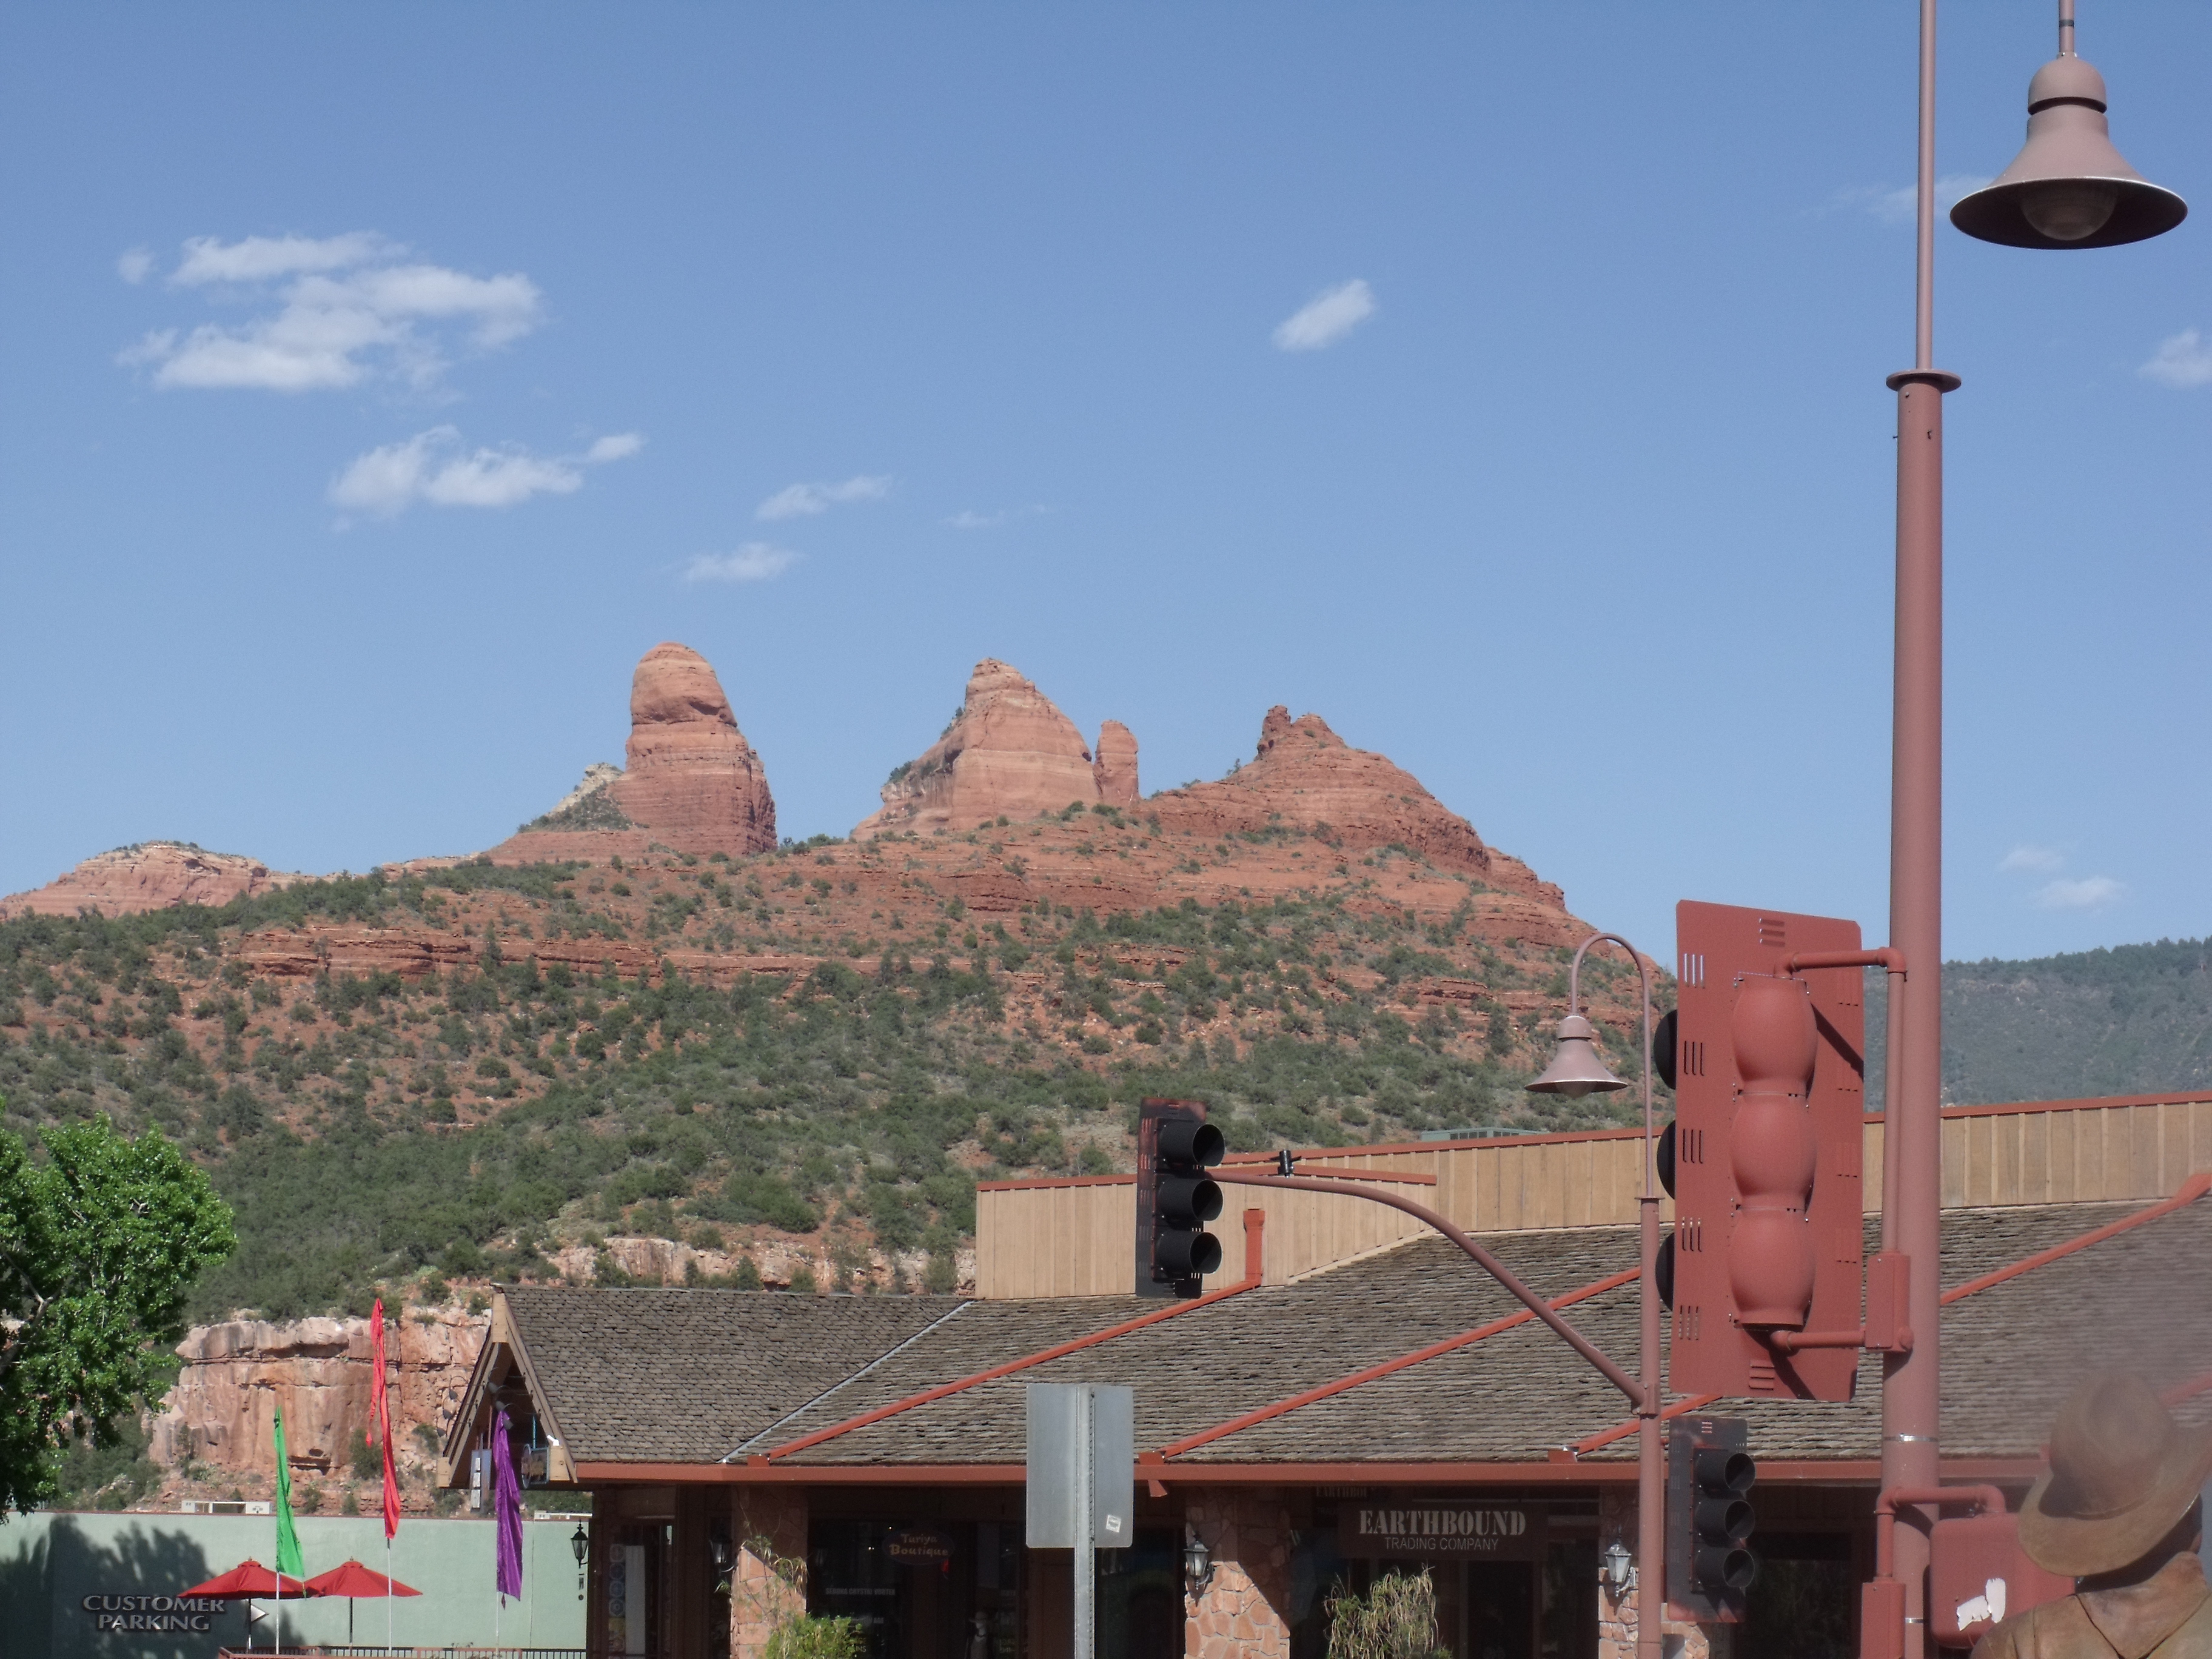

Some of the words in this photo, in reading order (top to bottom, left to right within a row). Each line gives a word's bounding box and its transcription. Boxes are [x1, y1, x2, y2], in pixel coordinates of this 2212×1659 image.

[1359, 1510, 1526, 1535] EARTHBOUND
[900, 1533, 937, 1546] Turiya
[1385, 1537, 1436, 1550] TRADING
[1439, 1538, 1498, 1550] COMPANY
[888, 1544, 948, 1557] Boutique
[82, 1595, 225, 1612] CUSTOMER
[98, 1614, 210, 1630] PARKING
